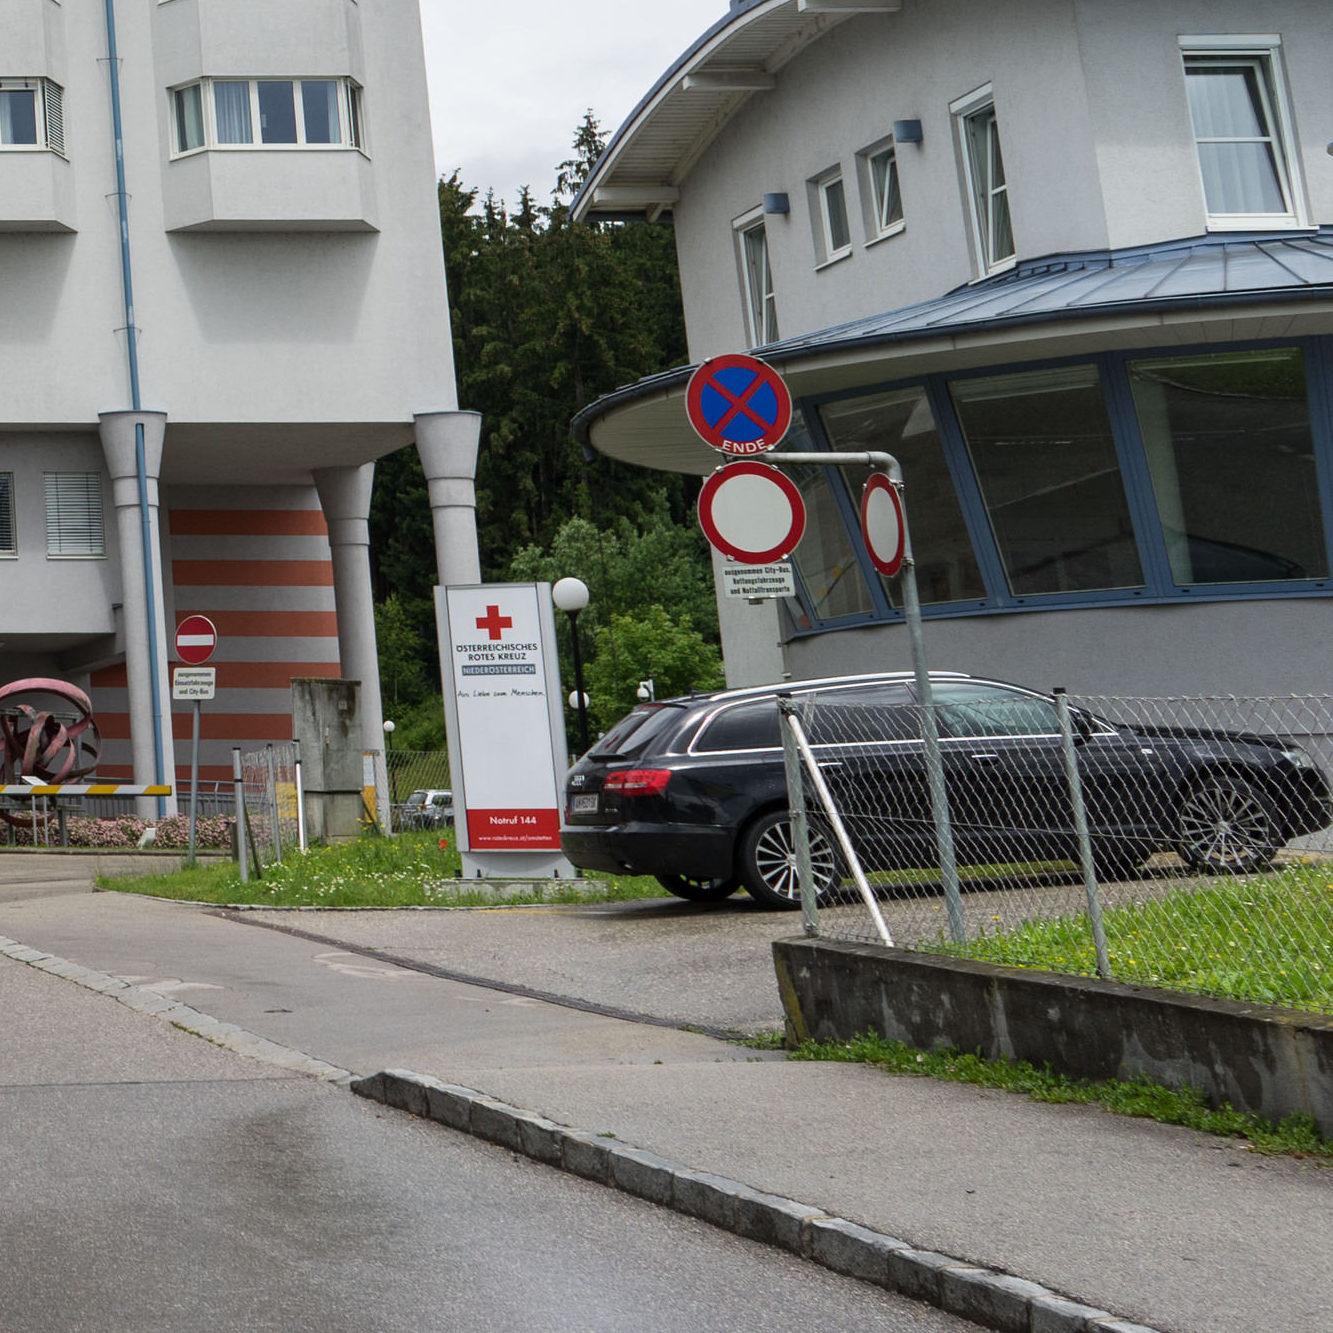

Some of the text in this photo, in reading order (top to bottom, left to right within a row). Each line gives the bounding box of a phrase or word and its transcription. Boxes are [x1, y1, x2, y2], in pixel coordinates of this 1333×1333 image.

[722, 438, 767, 453] ENDE
[724, 568, 763, 576] ausgenommen
[732, 576, 785, 585] Rettungsfahrzeuge
[742, 585, 790, 594] Notfalltransporte
[456, 642, 538, 653] ÖSTERREICHISCHES
[468, 652, 527, 661] ROTES KREUZ
[462, 665, 535, 675] NIEDERÖSTERREICH
[457, 690, 470, 698] Aus
[472, 689, 490, 697] Liebe
[489, 815, 537, 825] Notruf 144
